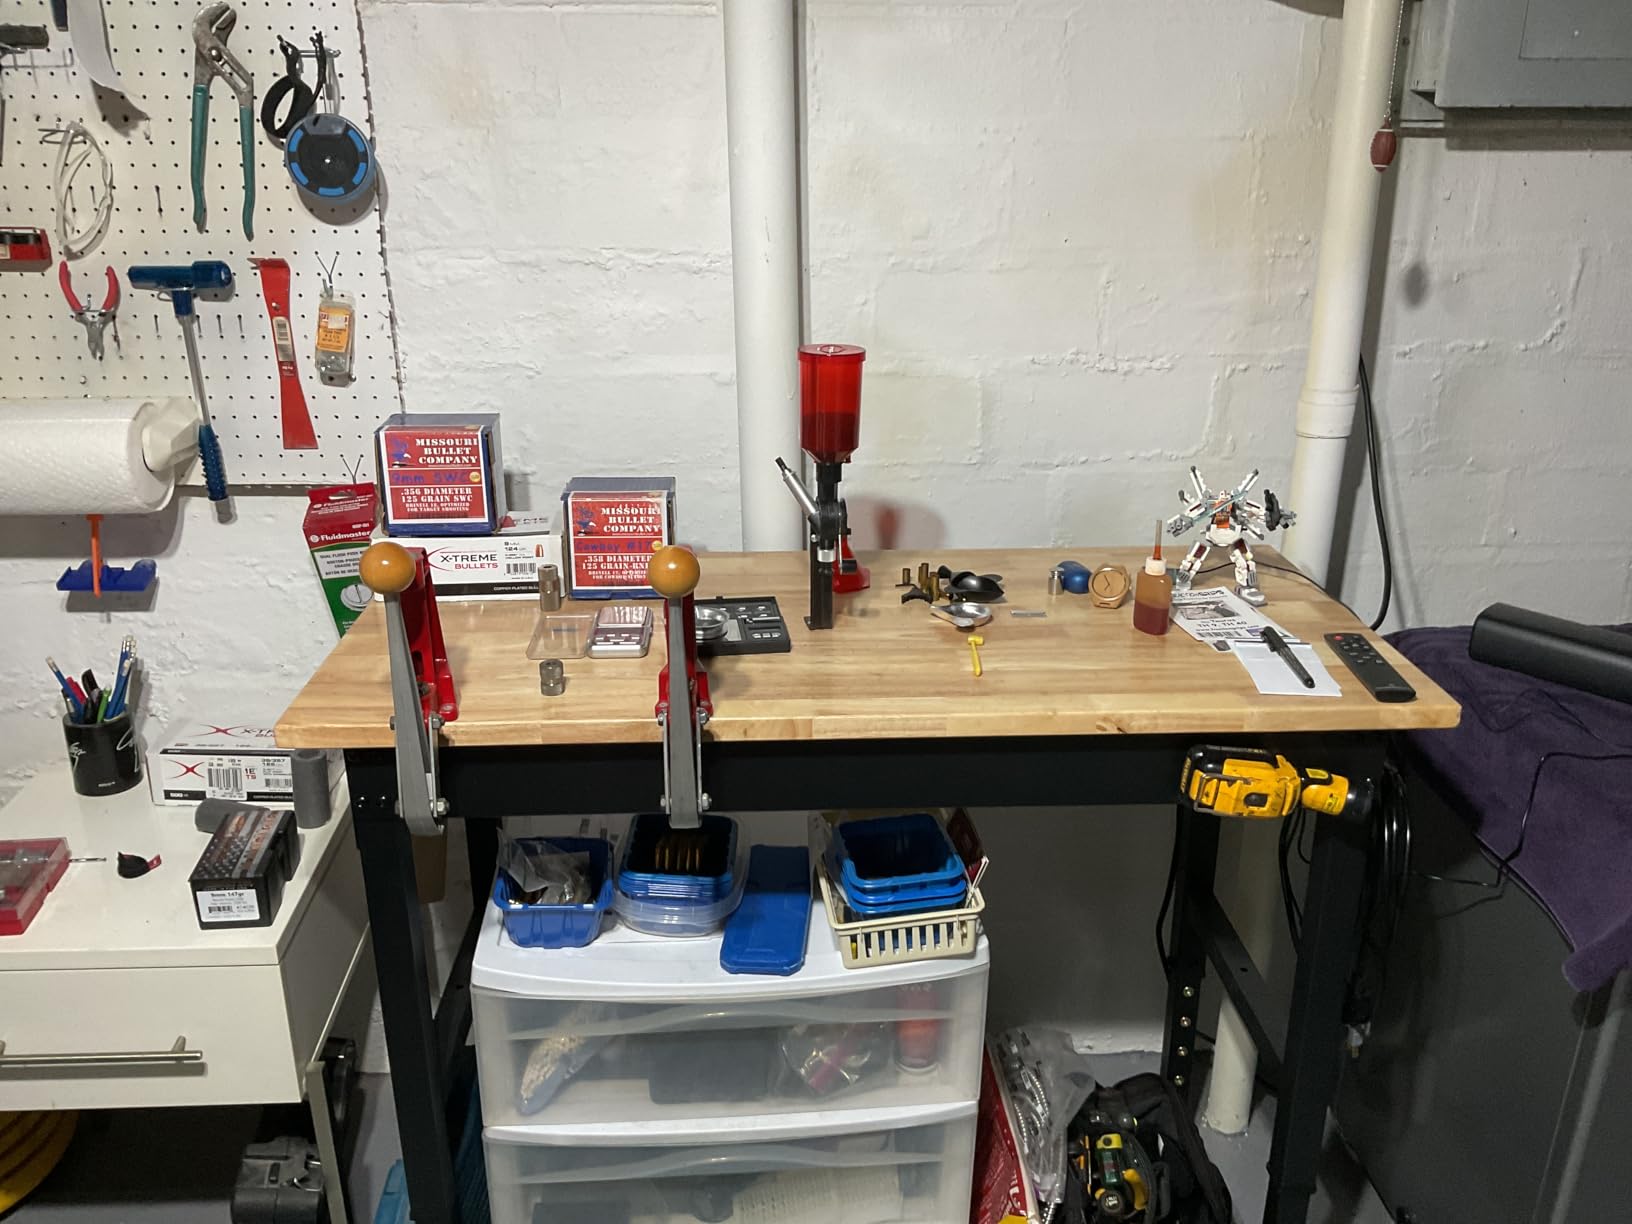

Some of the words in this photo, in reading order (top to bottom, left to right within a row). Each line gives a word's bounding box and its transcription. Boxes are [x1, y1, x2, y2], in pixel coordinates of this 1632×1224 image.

[415, 438, 478, 446] MISSOURI
[424, 447, 471, 455] BULLET
[418, 456, 477, 464] COMPANY
[424, 487, 472, 495] DIAMETER
[402, 495, 418, 503] 125
[453, 494, 473, 502] SWC
[601, 507, 661, 515] MISSOURI
[608, 516, 655, 524] BULLET
[603, 525, 660, 533] COMPANY
[320, 530, 371, 541] Fluidmaster
[575, 541, 619, 553] Cowboy
[440, 554, 498, 563] X-TREME
[584, 555, 604, 563] .358
[454, 562, 499, 570] BULLETS
[582, 562, 597, 570] 125
